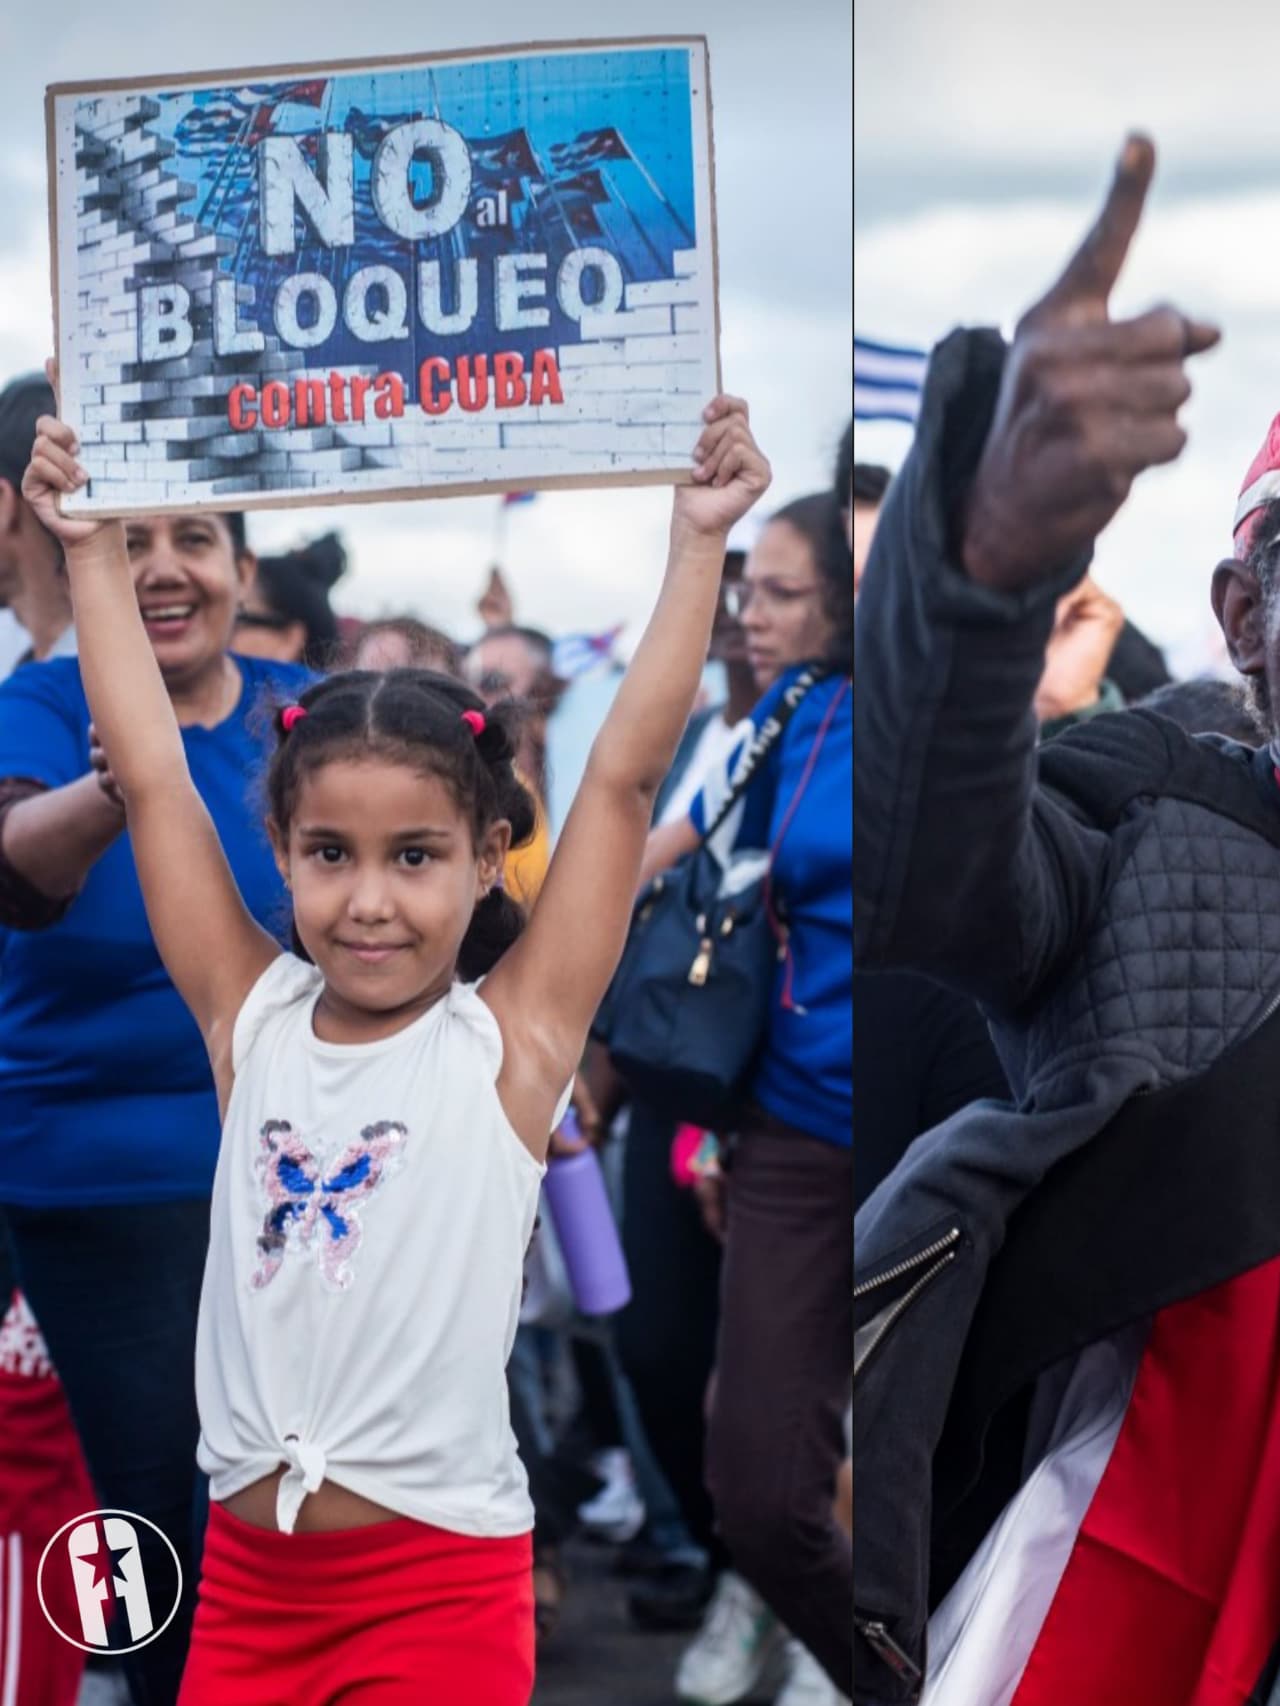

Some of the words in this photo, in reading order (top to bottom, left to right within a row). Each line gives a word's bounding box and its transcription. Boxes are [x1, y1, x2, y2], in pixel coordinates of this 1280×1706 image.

[257, 119, 472, 256] NO
[475, 189, 508, 228] al
[137, 246, 624, 364] BLOQUEO
[227, 370, 404, 432] contra
[418, 347, 564, 416] CUBA
